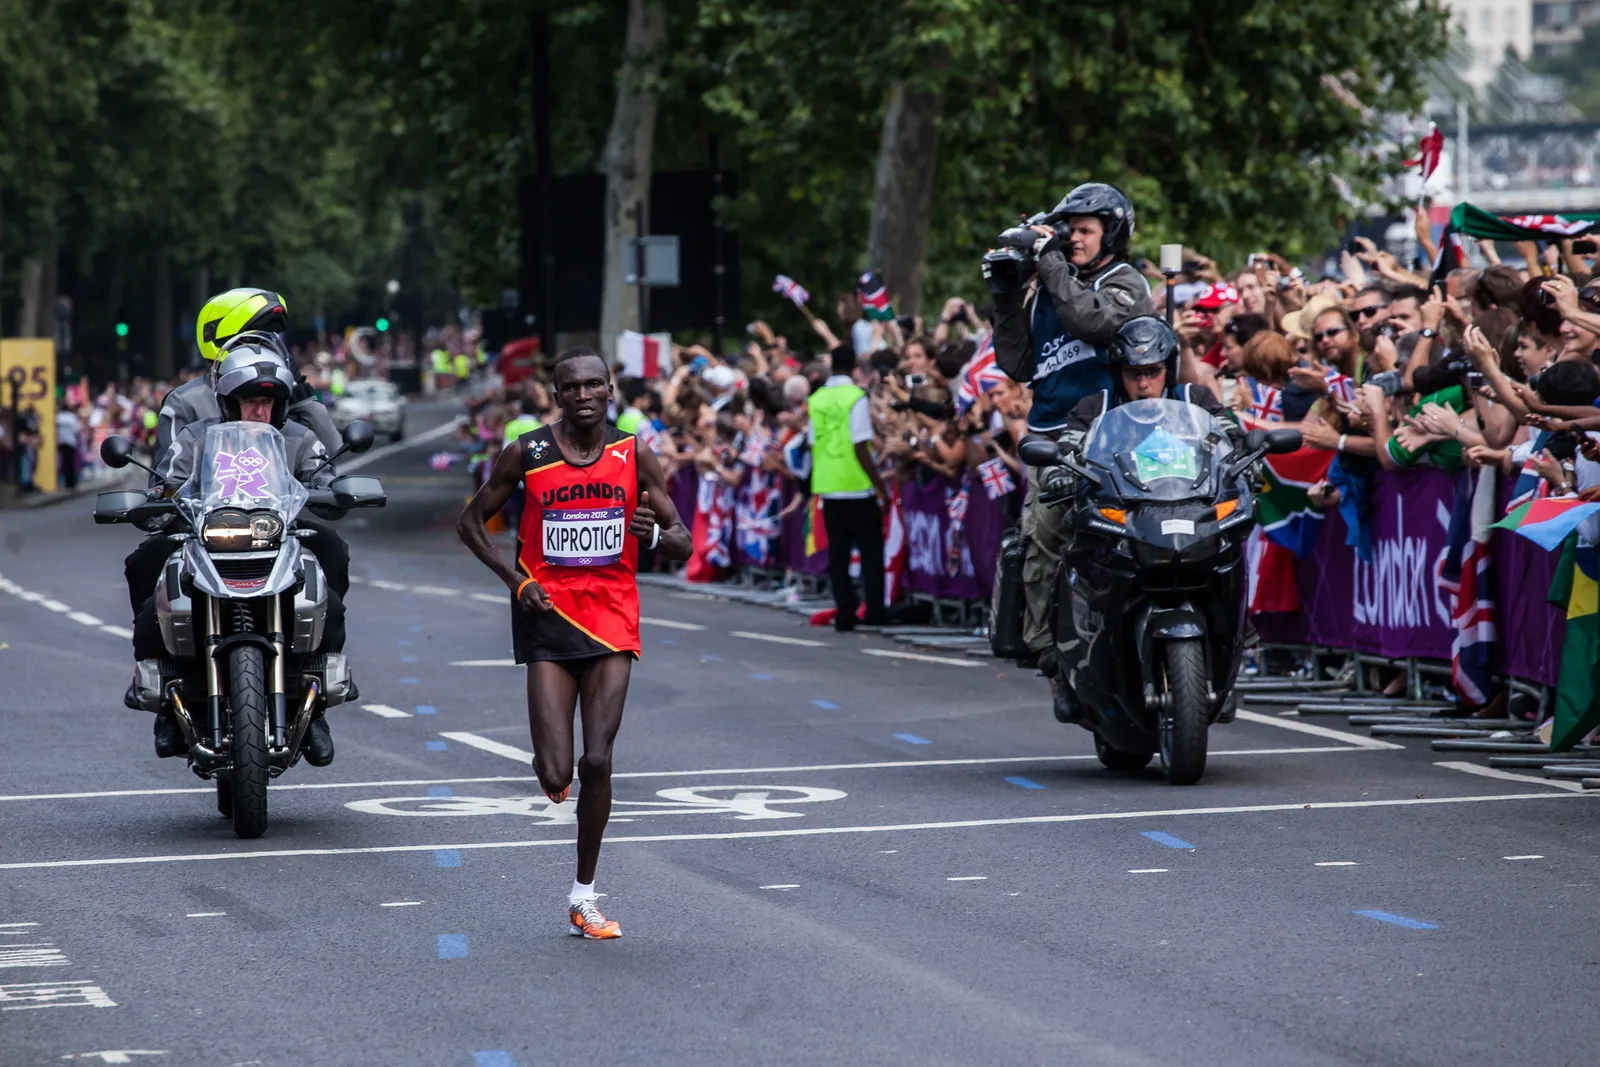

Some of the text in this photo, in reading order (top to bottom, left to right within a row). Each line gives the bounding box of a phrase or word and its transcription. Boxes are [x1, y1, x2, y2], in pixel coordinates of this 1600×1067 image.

[542, 483, 627, 506] UGANDA
[562, 511, 608, 520] London 2012
[546, 524, 622, 552] KIPROTICH
